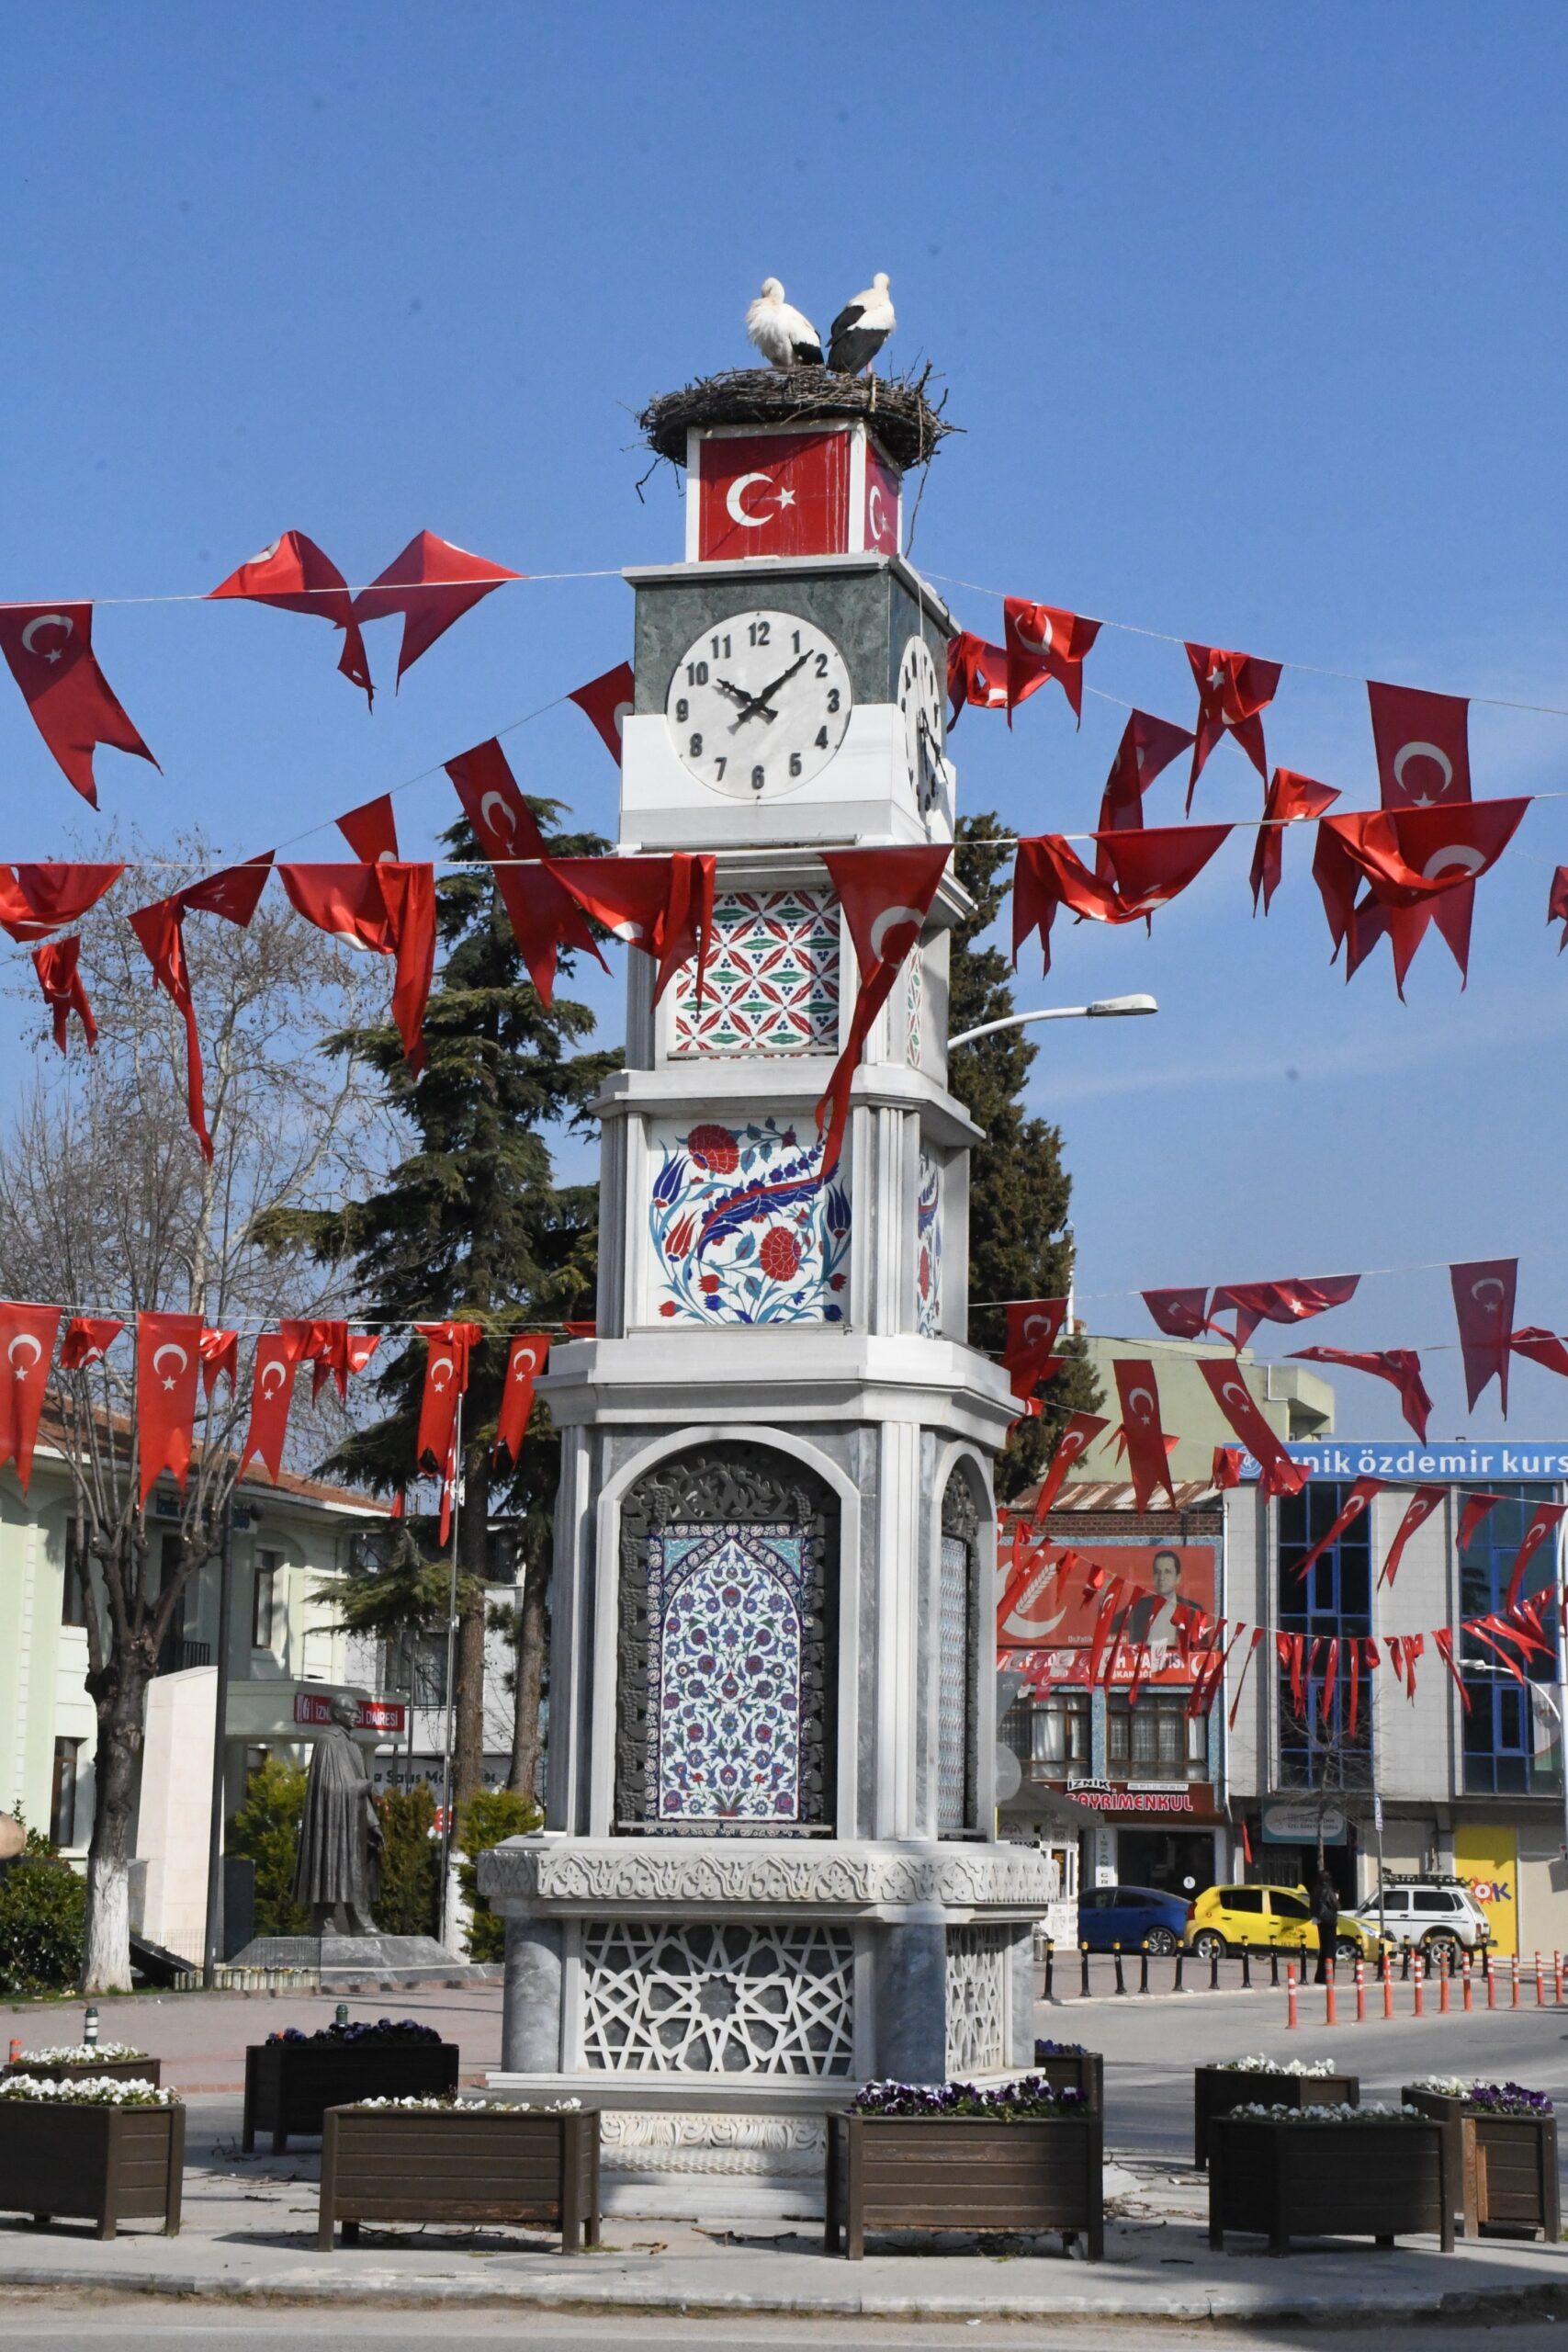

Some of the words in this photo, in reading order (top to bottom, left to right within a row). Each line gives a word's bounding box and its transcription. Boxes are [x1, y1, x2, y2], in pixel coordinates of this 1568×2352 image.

[710, 634, 731, 659] 11
[748, 621, 771, 647] 12
[791, 629, 800, 654] 1
[686, 661, 709, 686] 10
[815, 653, 829, 678] 2
[675, 698, 689, 722] 9
[828, 688, 840, 713] 3
[690, 732, 703, 757] 8
[815, 725, 829, 750] 4
[714, 757, 728, 782] 7
[751, 764, 765, 790] 6
[788, 752, 802, 777] 5
[1358, 1449, 1494, 1474] özdemir
[1067, 1778, 1111, 1792] İZNİK
